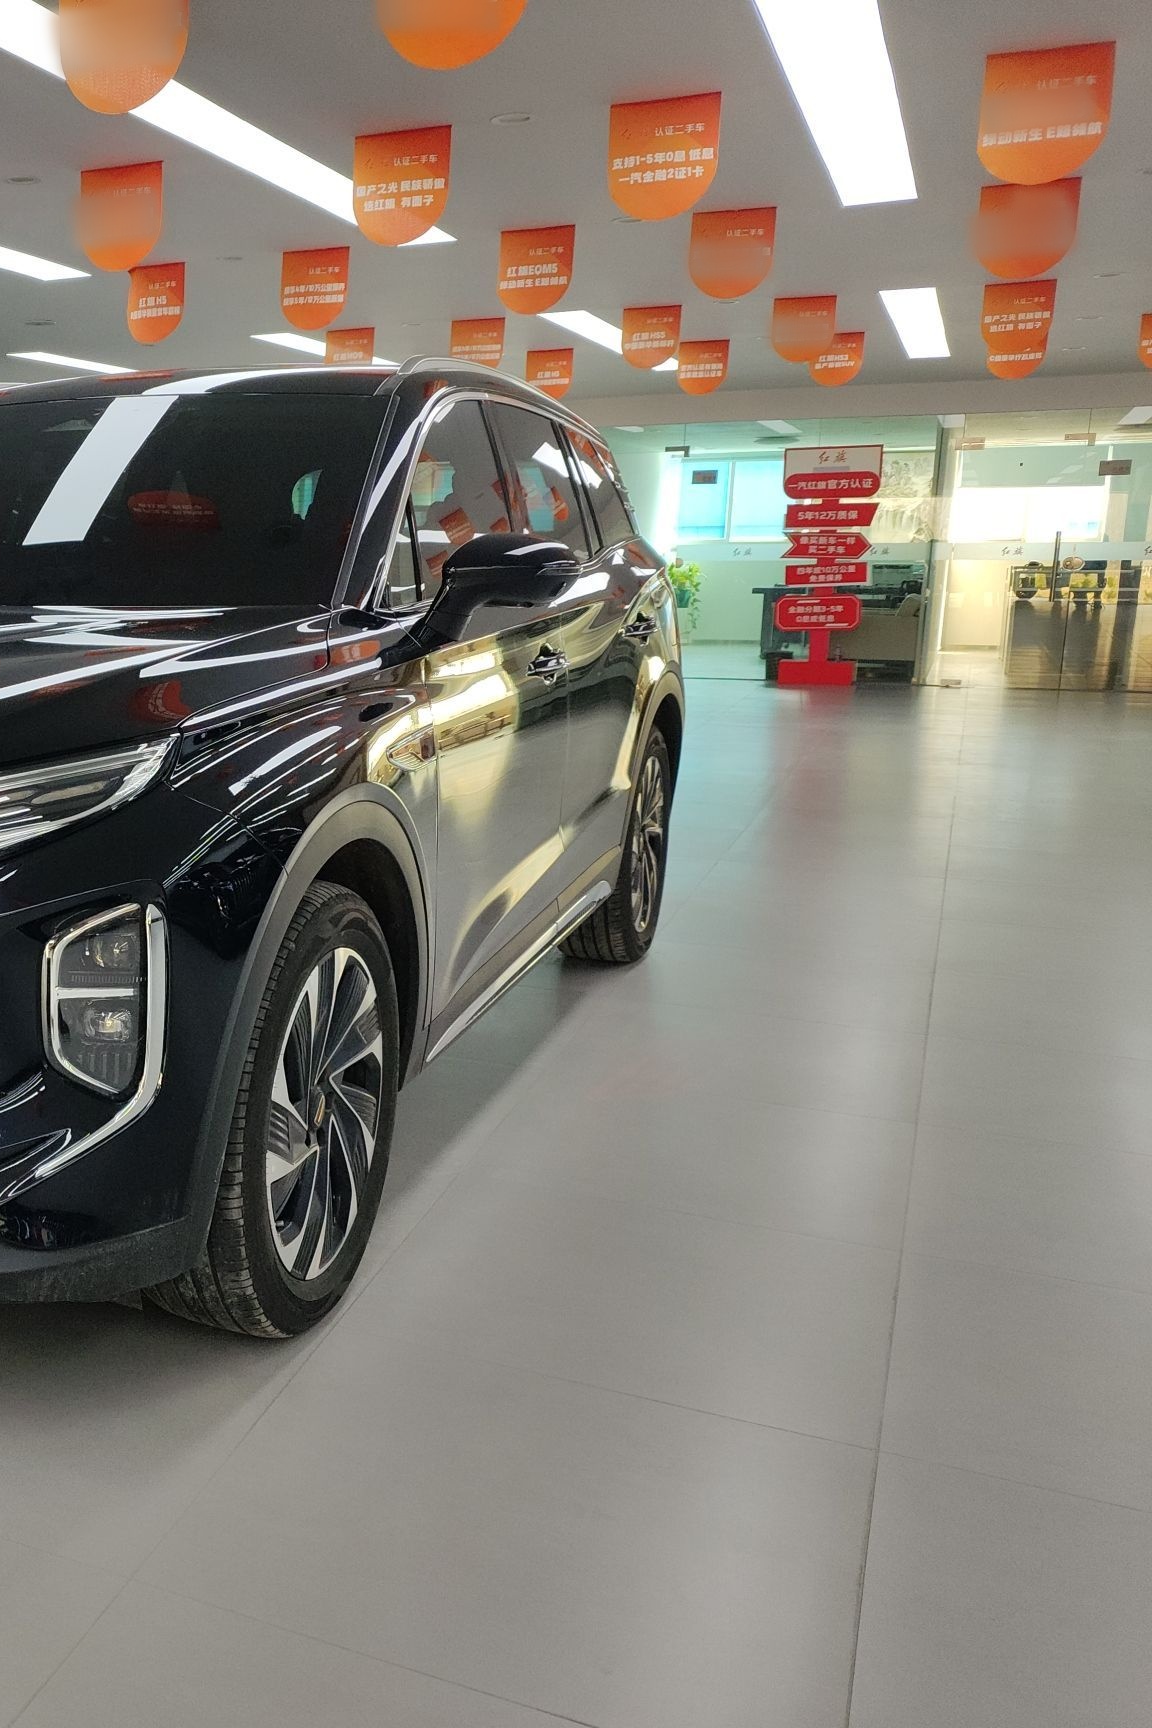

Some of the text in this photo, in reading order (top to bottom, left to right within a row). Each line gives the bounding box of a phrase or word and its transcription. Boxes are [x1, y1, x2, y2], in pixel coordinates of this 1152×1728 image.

[655, 123, 705, 136] 认证二手车
[393, 154, 438, 167] 认证二手车
[689, 147, 715, 161] 低息
[788, 478, 874, 491] 一汽红旗官方认证
[797, 510, 859, 521] 5年12万质保
[808, 545, 846, 554] 买二手车
